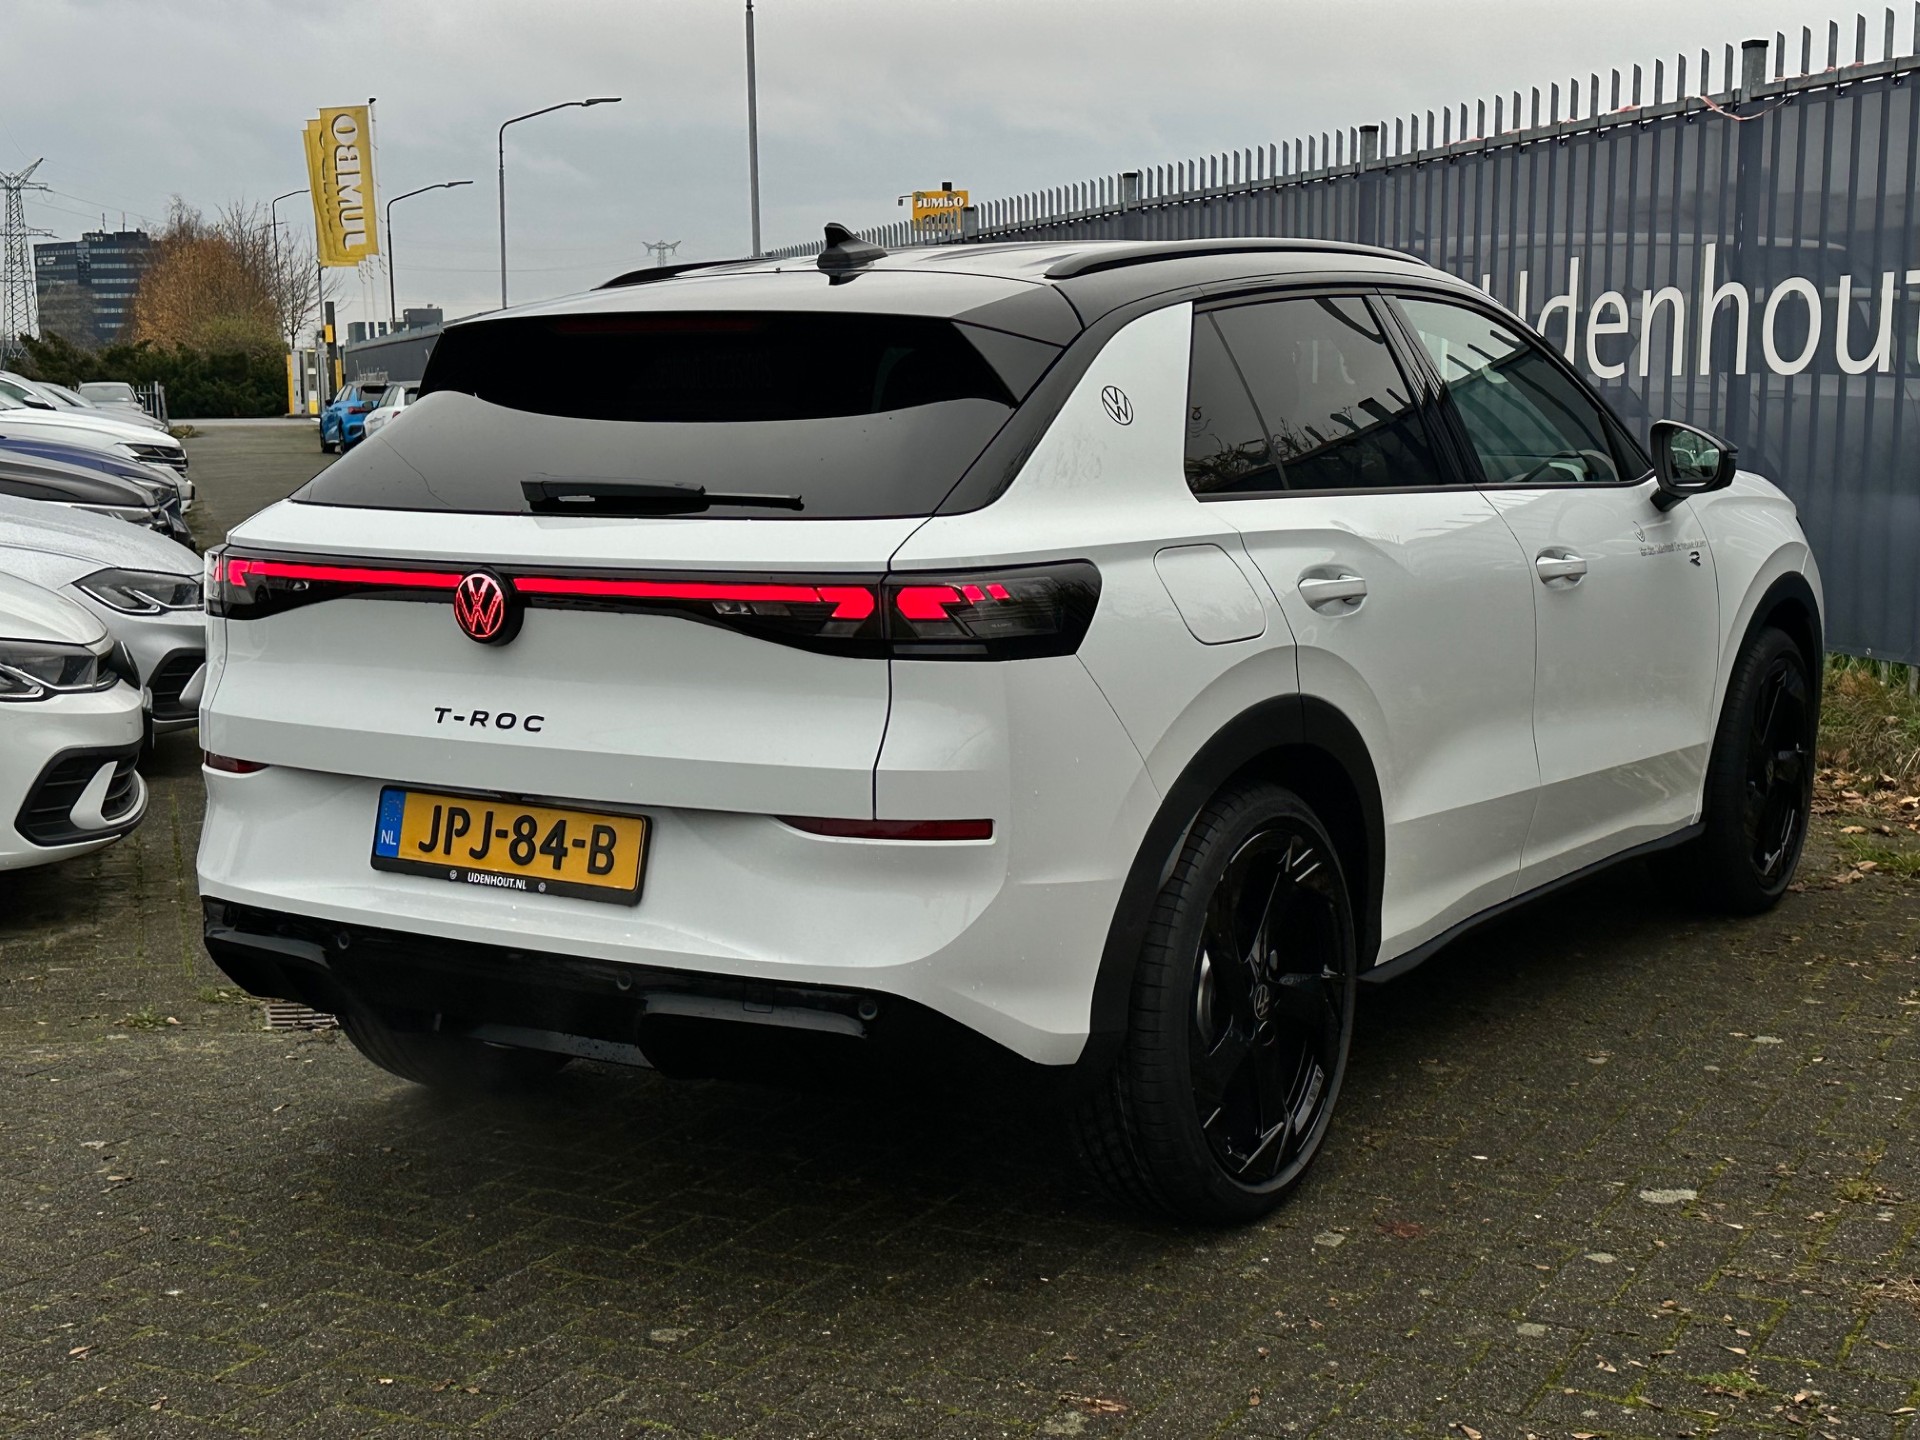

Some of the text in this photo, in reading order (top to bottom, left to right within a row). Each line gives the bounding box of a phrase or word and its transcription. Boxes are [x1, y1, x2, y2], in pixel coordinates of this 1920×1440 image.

[916, 196, 964, 209] JUMBO
[434, 707, 545, 733] T-ROC
[381, 829, 397, 846] NL
[418, 804, 618, 876] JPJ-84-B
[467, 872, 527, 890] UDENHOUT.NL
